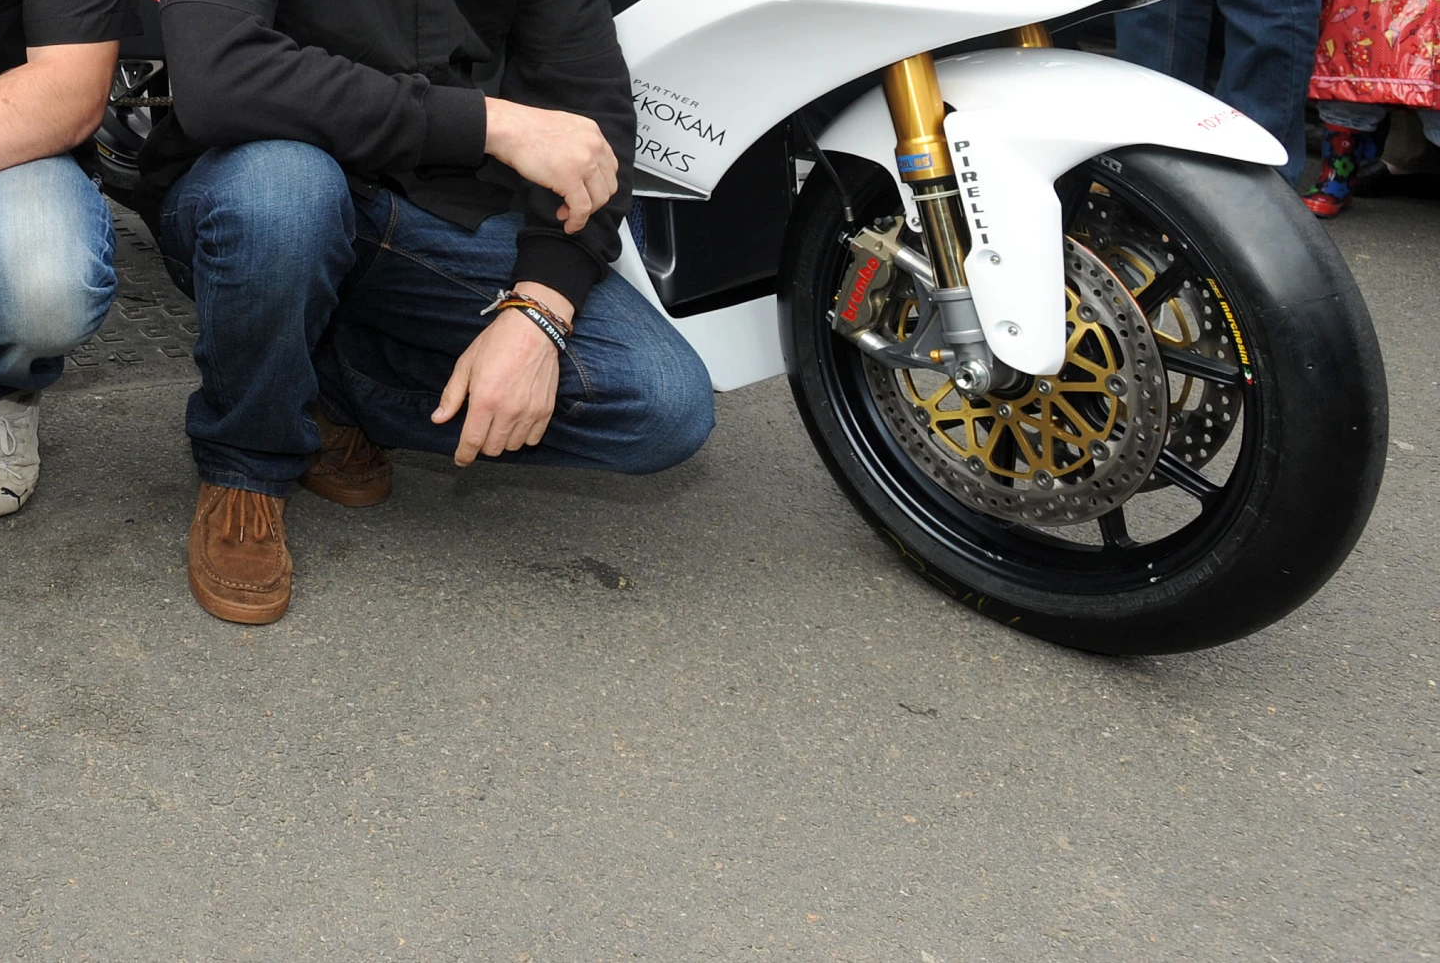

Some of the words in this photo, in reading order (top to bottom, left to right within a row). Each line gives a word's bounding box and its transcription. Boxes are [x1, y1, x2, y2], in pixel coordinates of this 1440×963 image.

[633, 78, 700, 109] PARTNER
[640, 96, 726, 147] KOKAM
[954, 140, 990, 245] PIRELLI
[841, 257, 880, 322] brembo
[526, 307, 541, 321] IOM
[538, 317, 548, 328] TT
[545, 325, 561, 340] 2013
[1219, 301, 1251, 365] marchesini
